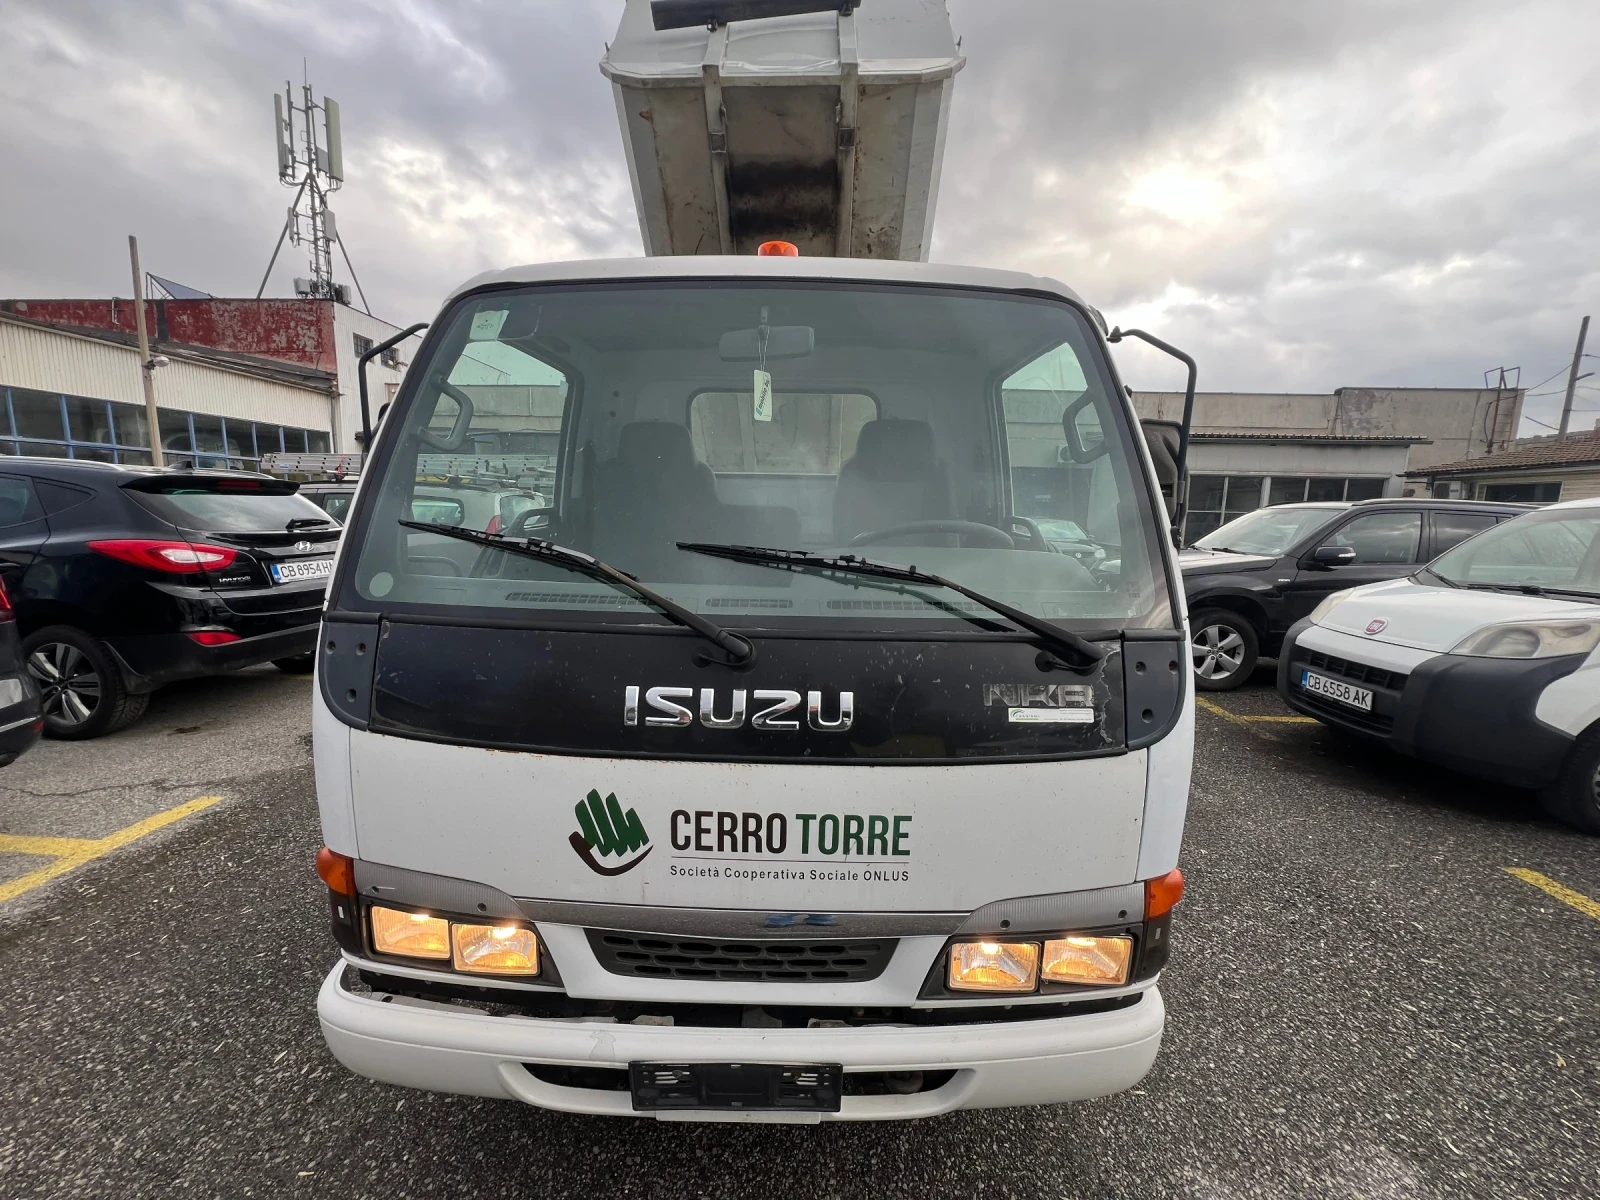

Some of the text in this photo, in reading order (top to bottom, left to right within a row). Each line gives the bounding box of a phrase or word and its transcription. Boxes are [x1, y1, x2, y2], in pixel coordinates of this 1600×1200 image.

[280, 565, 297, 578] CB
[296, 562, 323, 576] 8954
[1308, 675, 1370, 707] CB 6558 AK
[624, 685, 854, 732] ISUZU
[670, 809, 913, 856] CERRO TORRE
[670, 865, 910, 882] Società Cooperativa Sociale ONLUS
